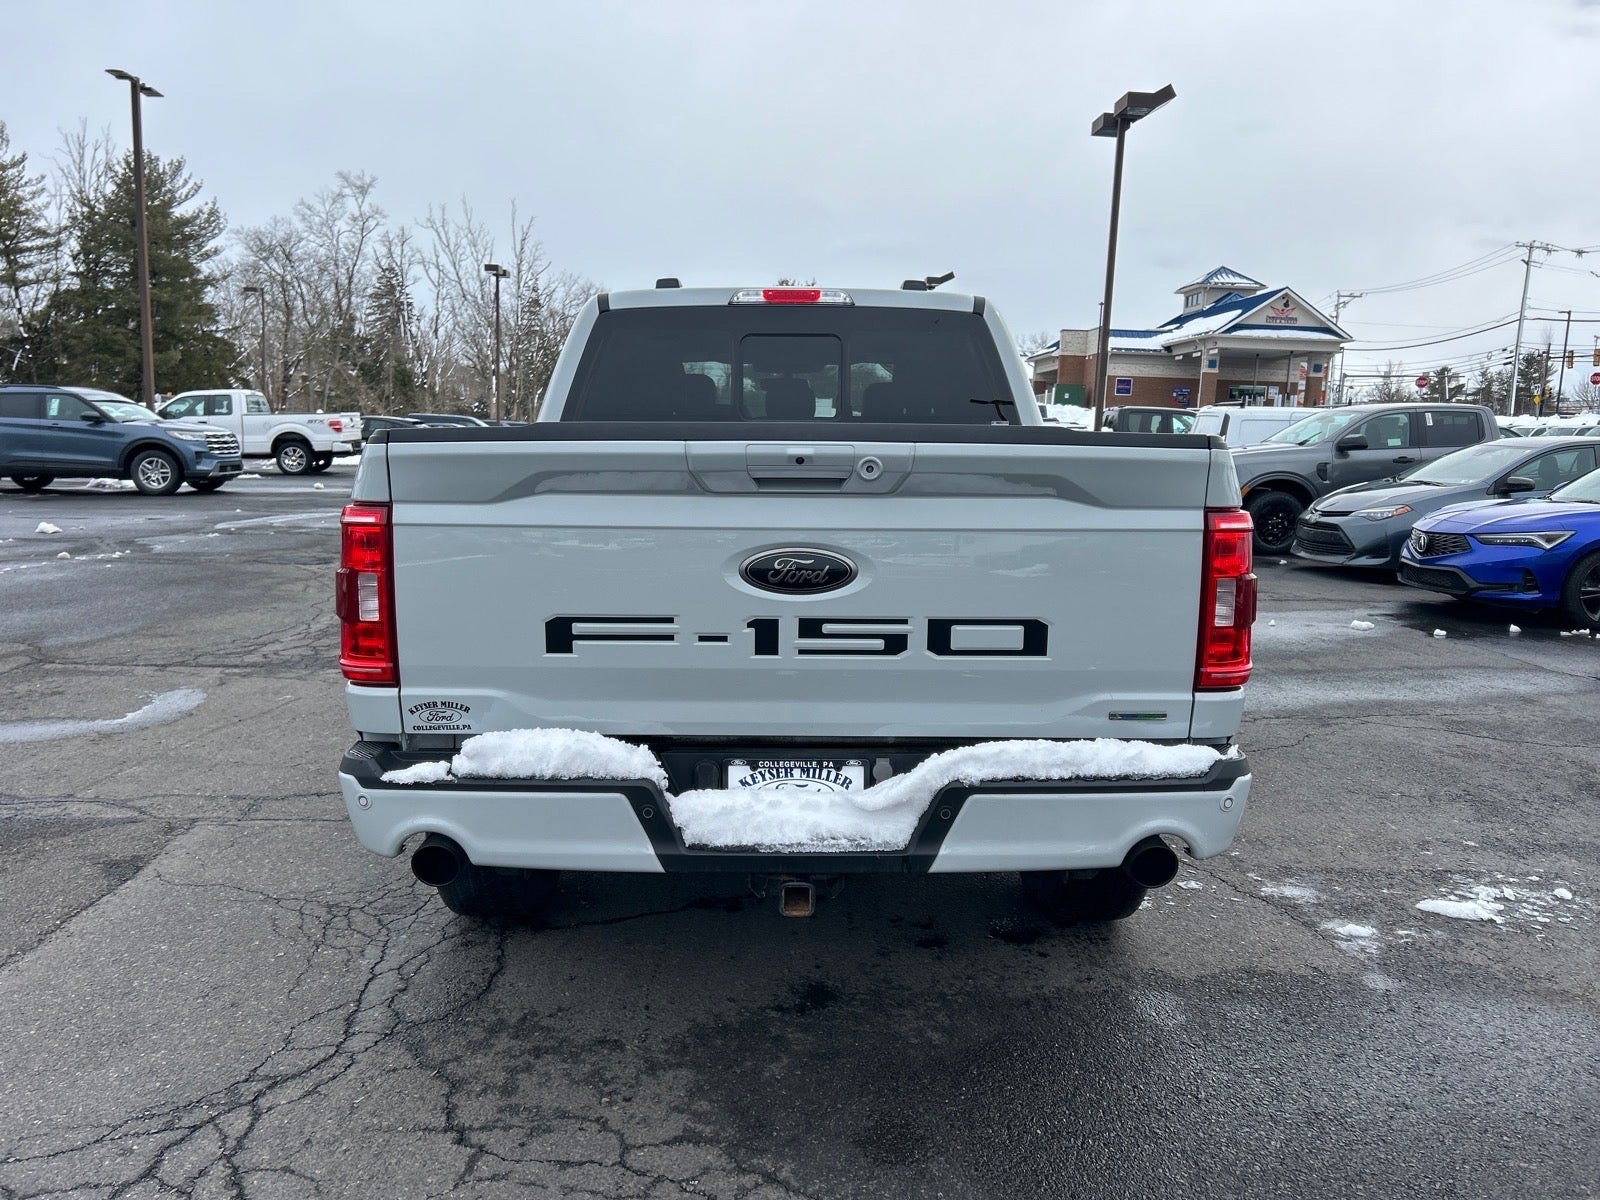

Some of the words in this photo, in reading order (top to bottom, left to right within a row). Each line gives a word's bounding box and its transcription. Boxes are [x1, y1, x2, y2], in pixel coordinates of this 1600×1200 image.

[767, 557, 830, 583] Ford
[543, 615, 1050, 659] F-150
[408, 701, 439, 715] KEYSER
[440, 701, 471, 714] MILLER
[426, 710, 454, 722] Ford
[758, 760, 820, 768] COLLEGEVILLE,
[823, 760, 834, 768] PA
[738, 768, 795, 788] KEYSER
[799, 768, 853, 791] MILLER
